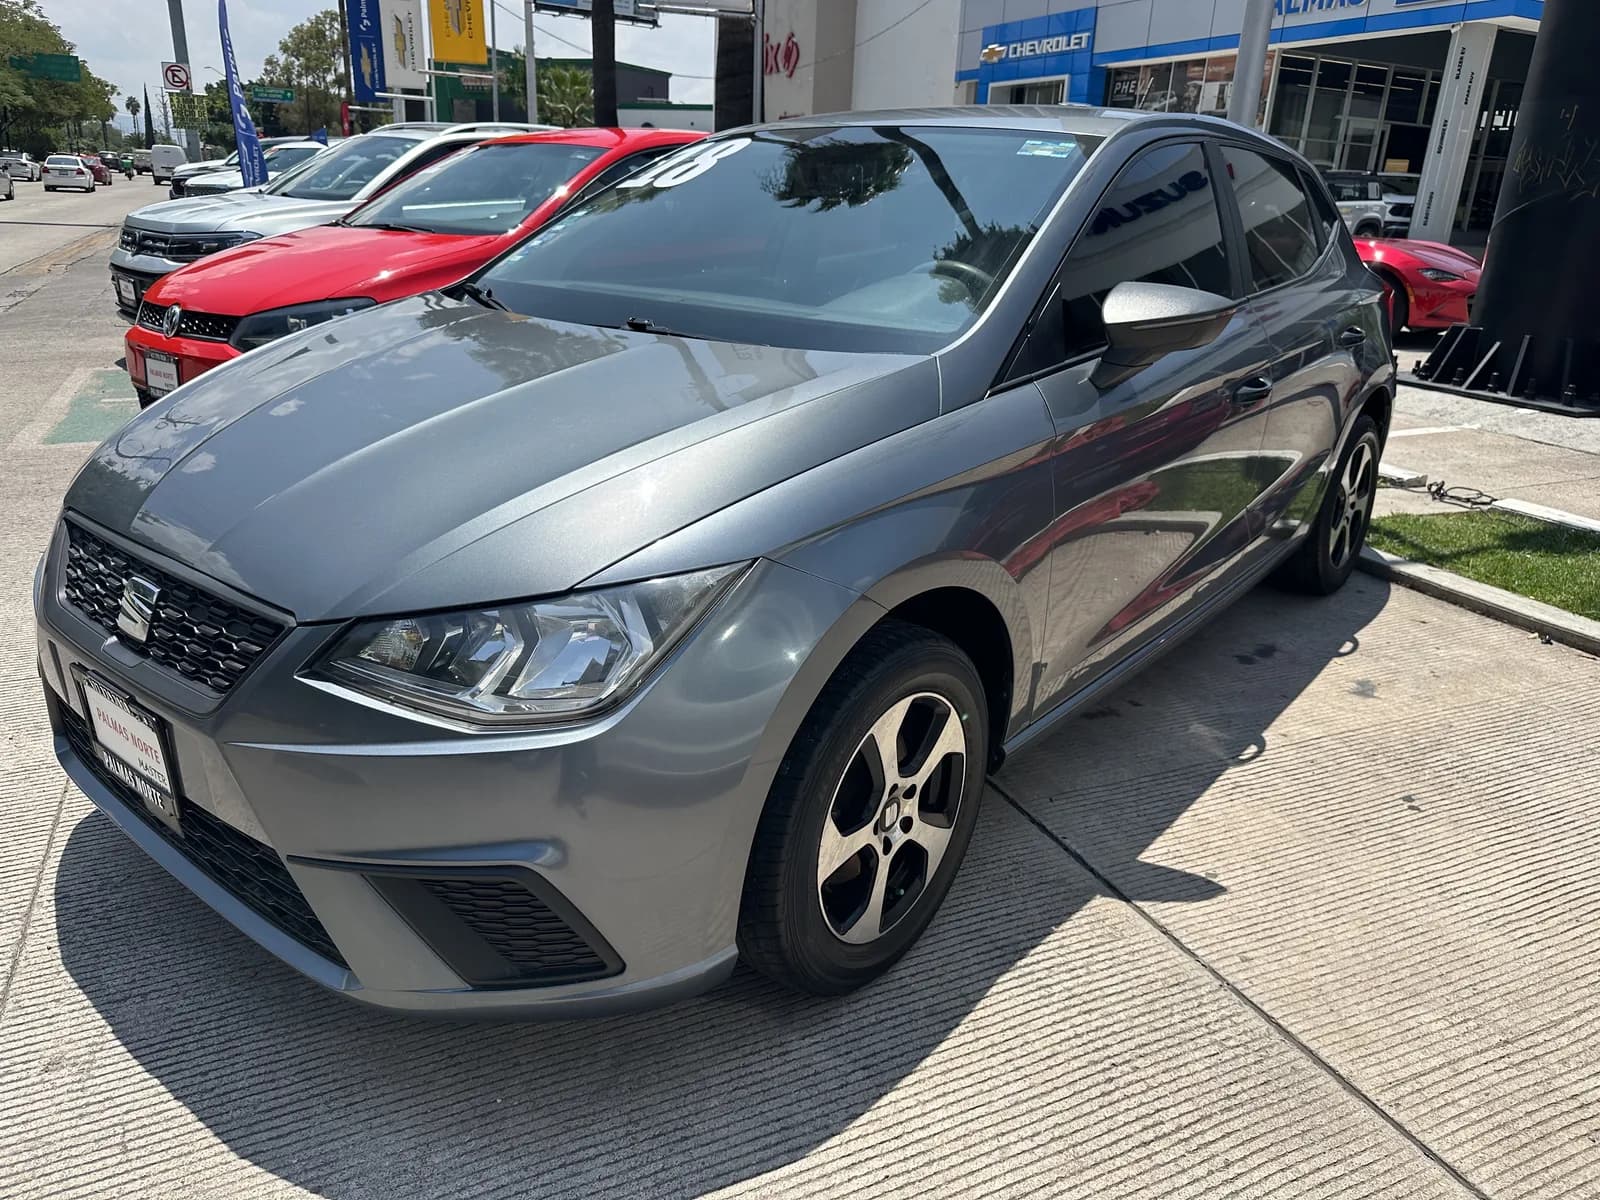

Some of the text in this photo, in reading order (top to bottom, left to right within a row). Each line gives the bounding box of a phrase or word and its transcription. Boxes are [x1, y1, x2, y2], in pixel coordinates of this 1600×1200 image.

[407, 11, 417, 72] CHEVROLET
[1008, 32, 1091, 58] CHEVROLET
[615, 137, 752, 188] 18
[96, 707, 161, 764] PALMAS NORTE
[102, 751, 165, 810] PALMAS NORTE
[137, 757, 168, 786] MASTER
